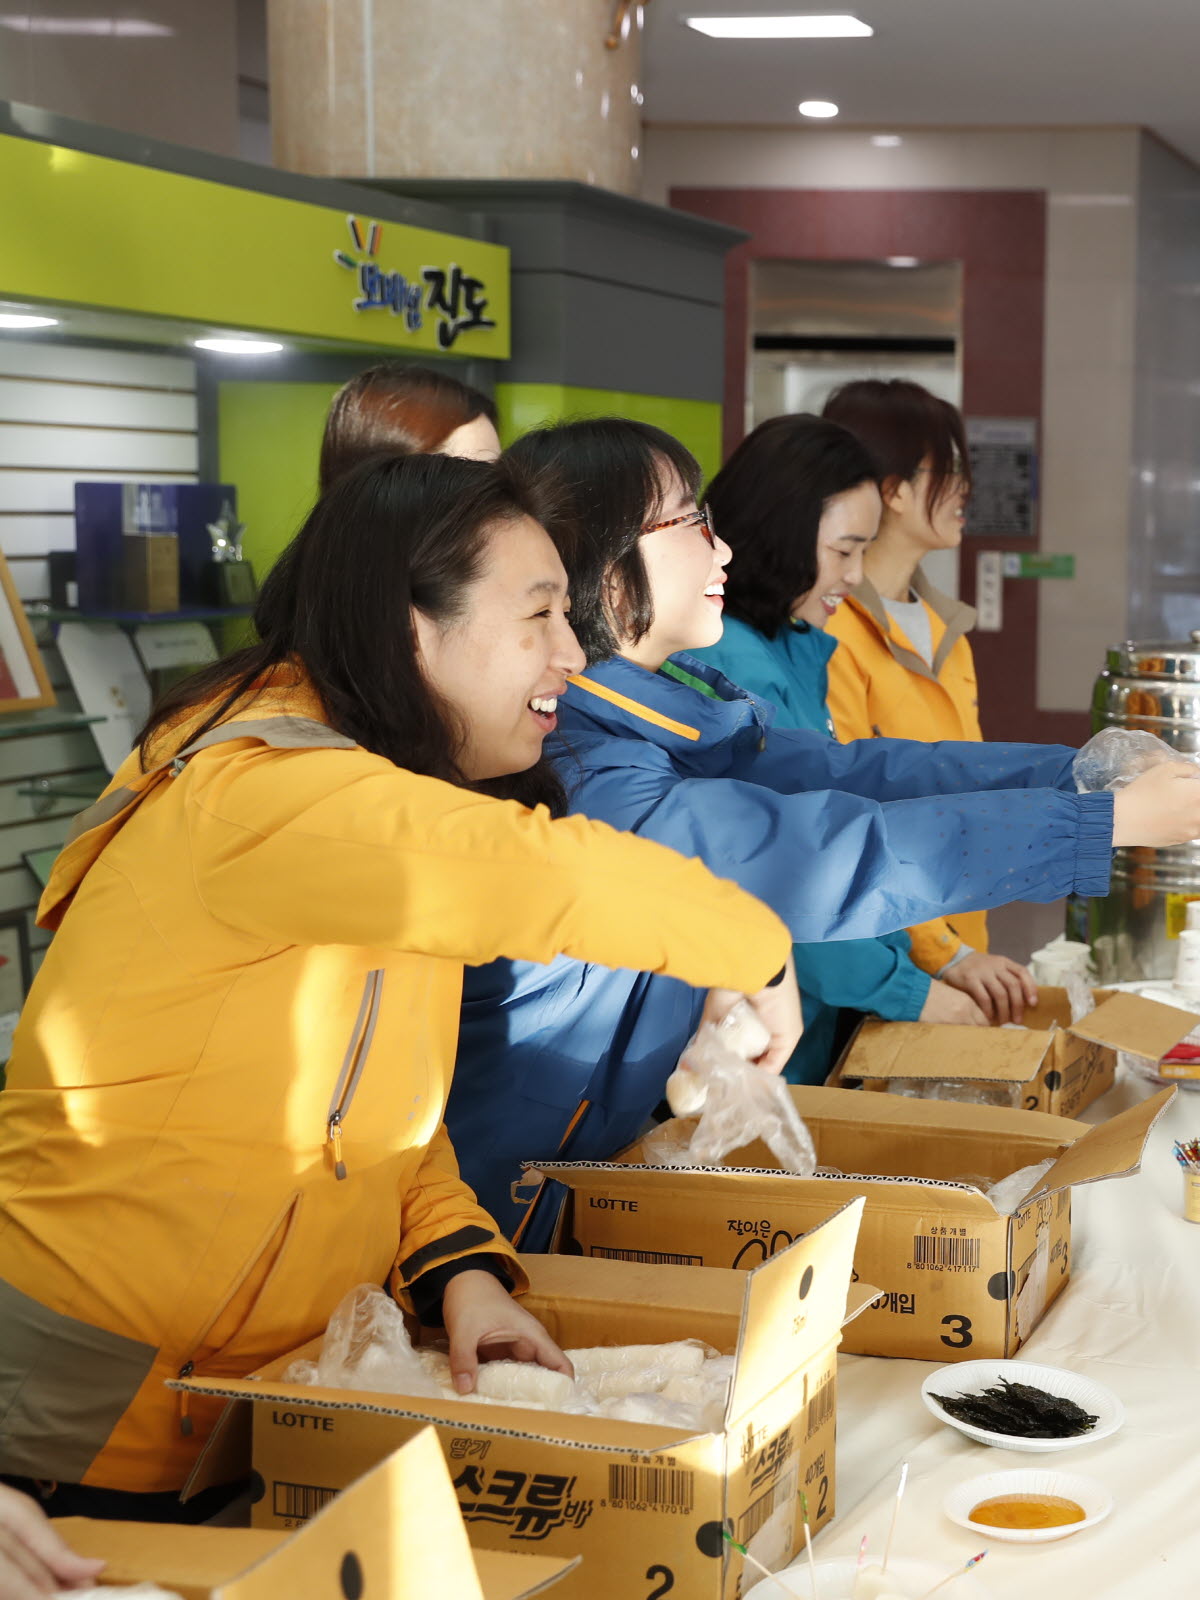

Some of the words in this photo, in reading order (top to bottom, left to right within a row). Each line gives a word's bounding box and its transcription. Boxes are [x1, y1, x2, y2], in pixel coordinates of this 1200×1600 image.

[420, 263, 496, 351] 진도
[589, 1196, 638, 1212] LOTTE
[726, 1219, 771, 1239] 잘익은
[940, 1314, 973, 1348] 3
[272, 1410, 335, 1432] LOTTE
[450, 1437, 492, 1460] 딸기
[816, 1475, 829, 1520] 2
[645, 1564, 675, 1600] 2
